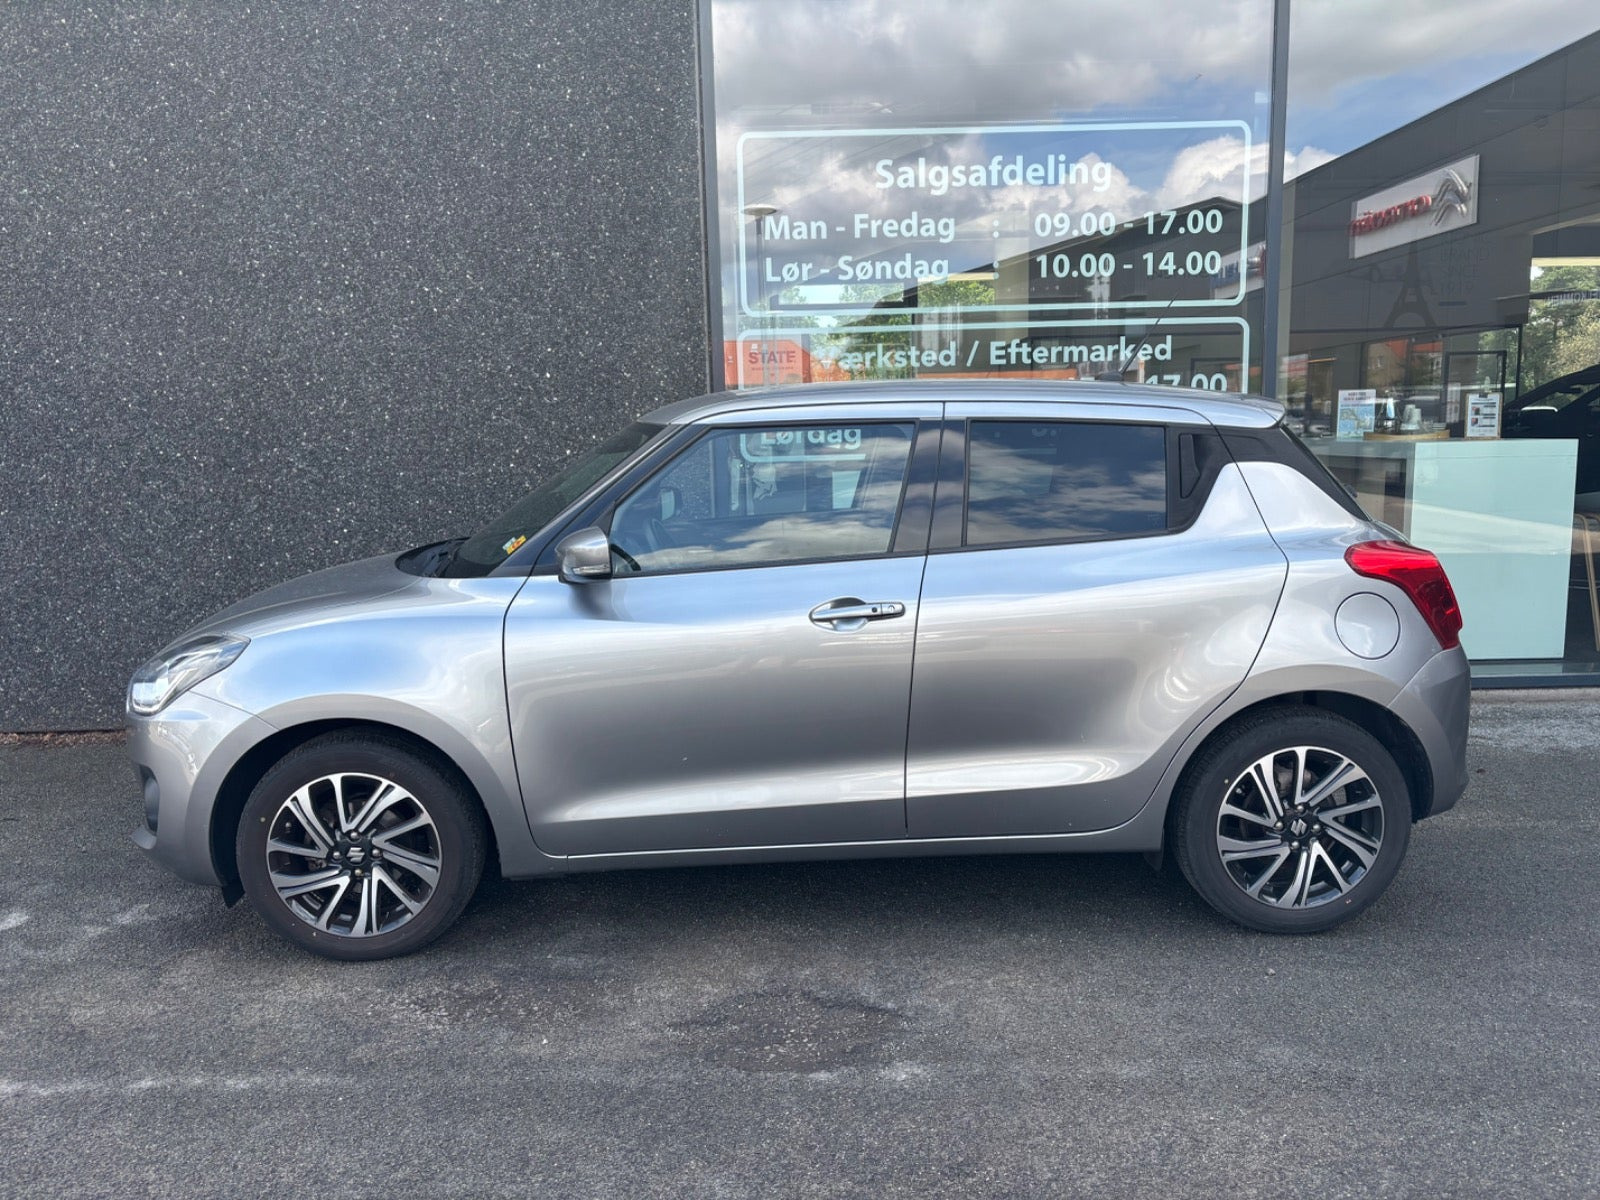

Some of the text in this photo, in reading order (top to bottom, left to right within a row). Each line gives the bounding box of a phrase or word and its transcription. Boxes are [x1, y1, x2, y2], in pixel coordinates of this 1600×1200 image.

[875, 153, 1112, 195] Salgsafdeling
[764, 215, 827, 240] Man
[854, 211, 955, 243] Fredag
[1034, 212, 1115, 237] 09.00
[1144, 209, 1223, 235] 17.00
[765, 257, 812, 283] Lør
[838, 254, 949, 284] Søndag
[1036, 253, 1115, 278] 10.00
[1142, 250, 1222, 276] 14.00
[748, 350, 796, 364] STATE
[990, 335, 1172, 365] Eftermarked
